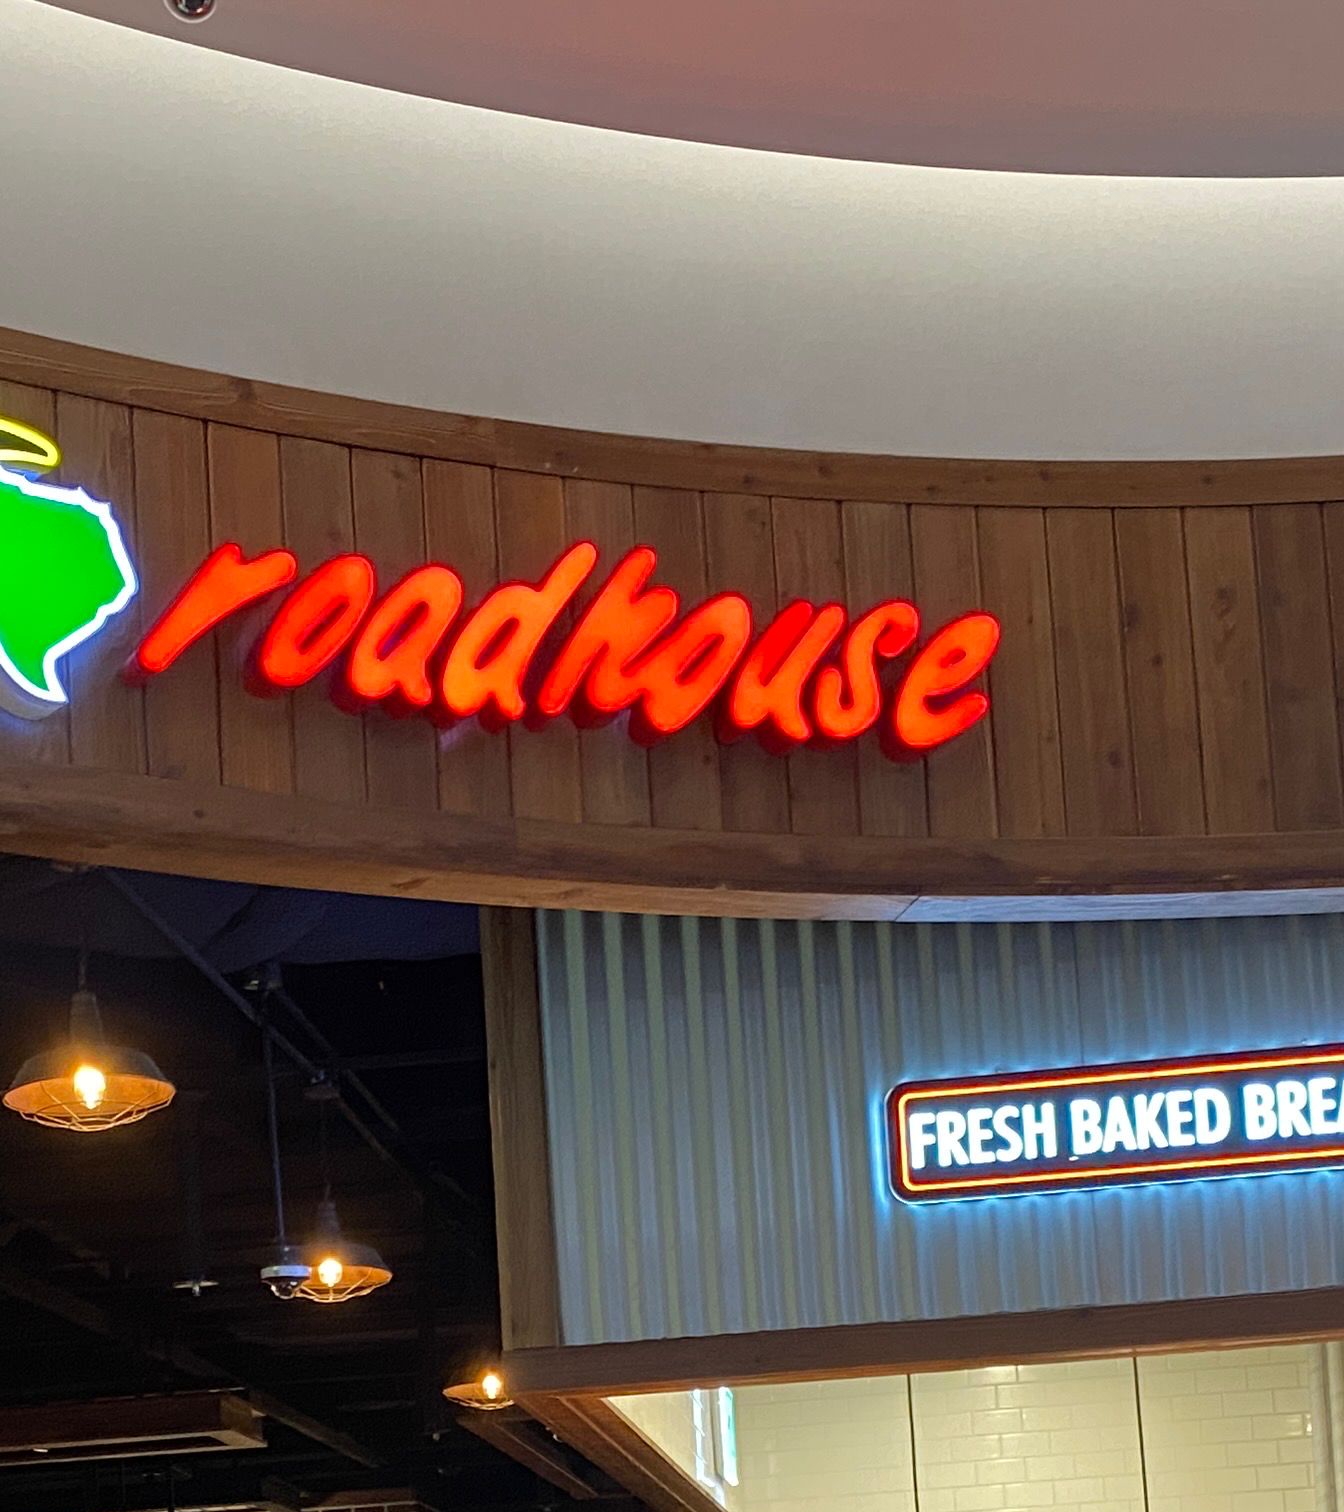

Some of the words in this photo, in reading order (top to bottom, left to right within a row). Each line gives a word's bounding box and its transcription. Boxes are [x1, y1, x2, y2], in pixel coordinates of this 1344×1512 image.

[134, 541, 1001, 755] roadhouse
[908, 1101, 1057, 1169] FRESH
[1069, 1086, 1231, 1158] BAKED
